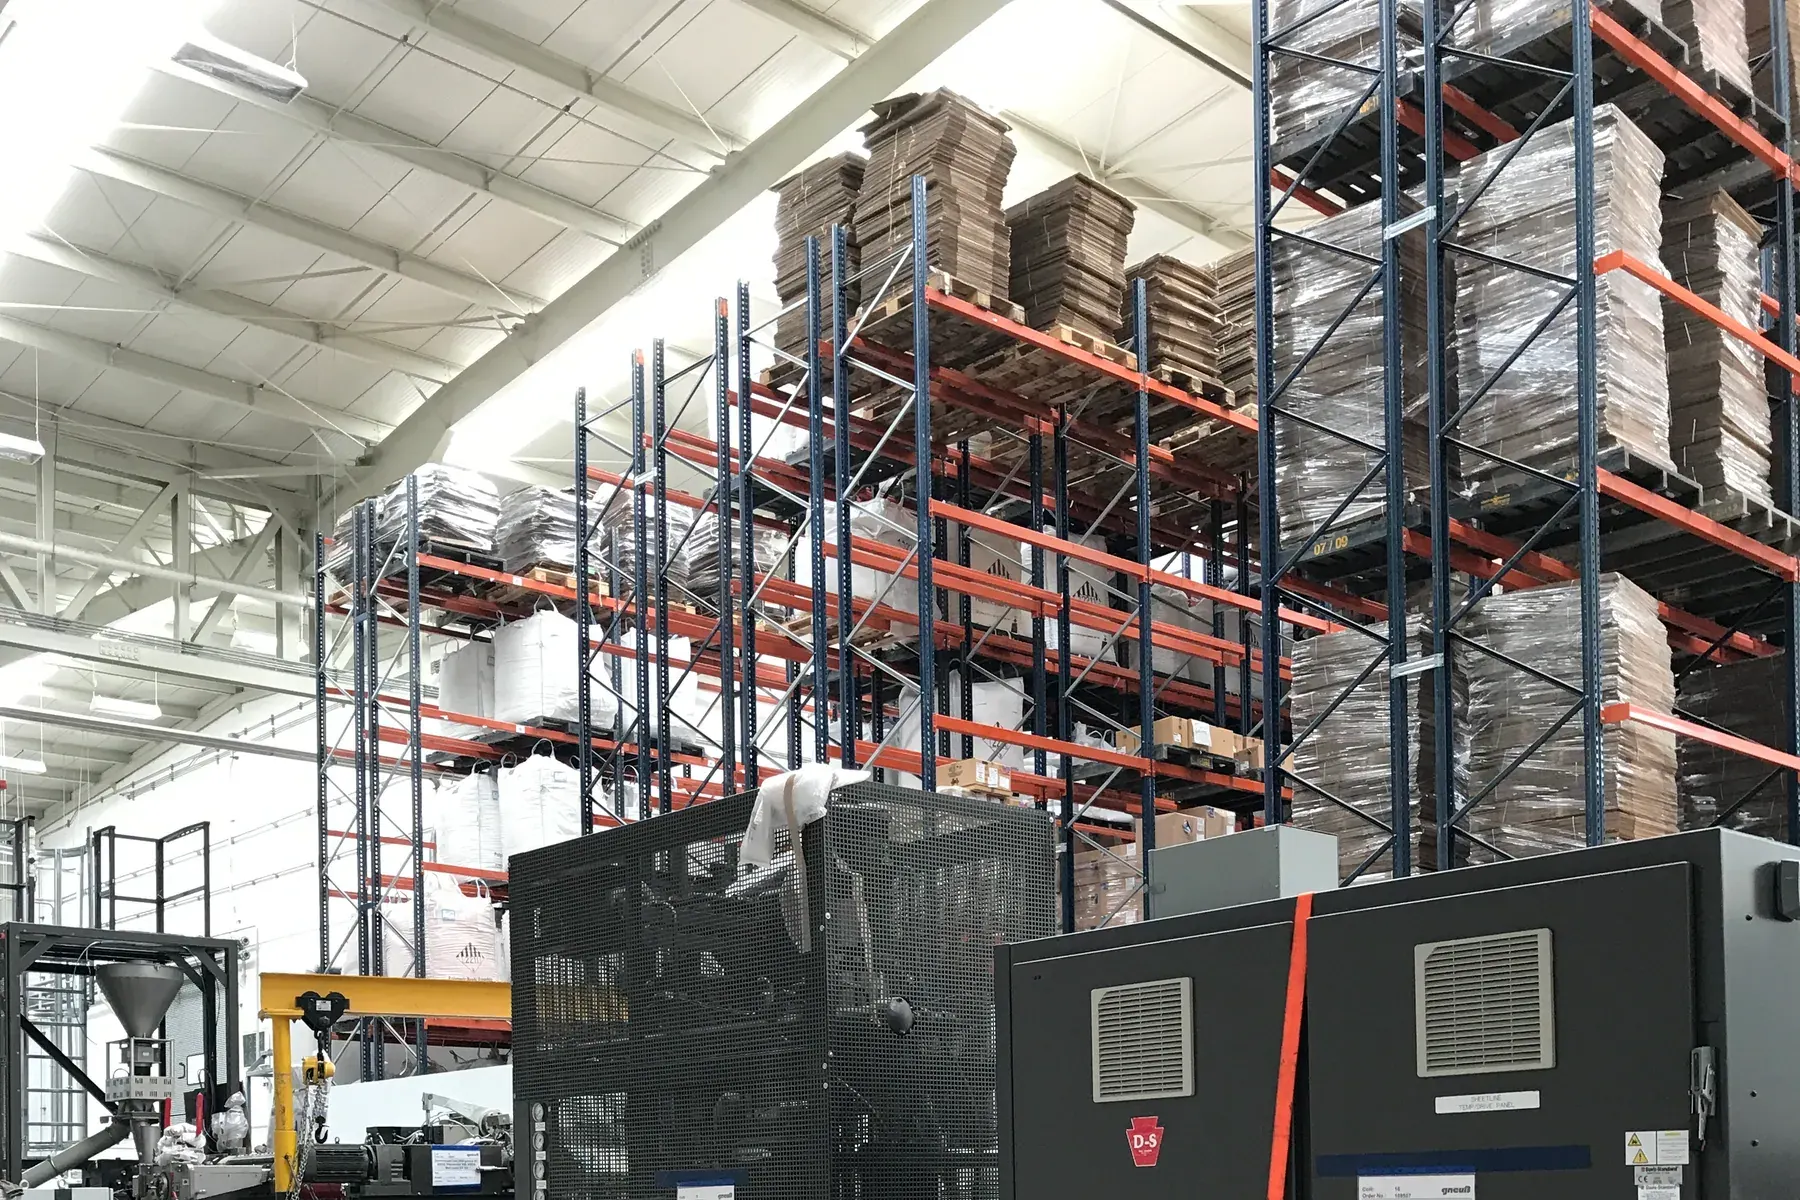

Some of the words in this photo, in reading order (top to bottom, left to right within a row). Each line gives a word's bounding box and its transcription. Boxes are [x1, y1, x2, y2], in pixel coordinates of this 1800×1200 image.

[1313, 542, 1326, 556] 07
[1335, 535, 1349, 550] 09
[1133, 1133, 1157, 1149] D-S
